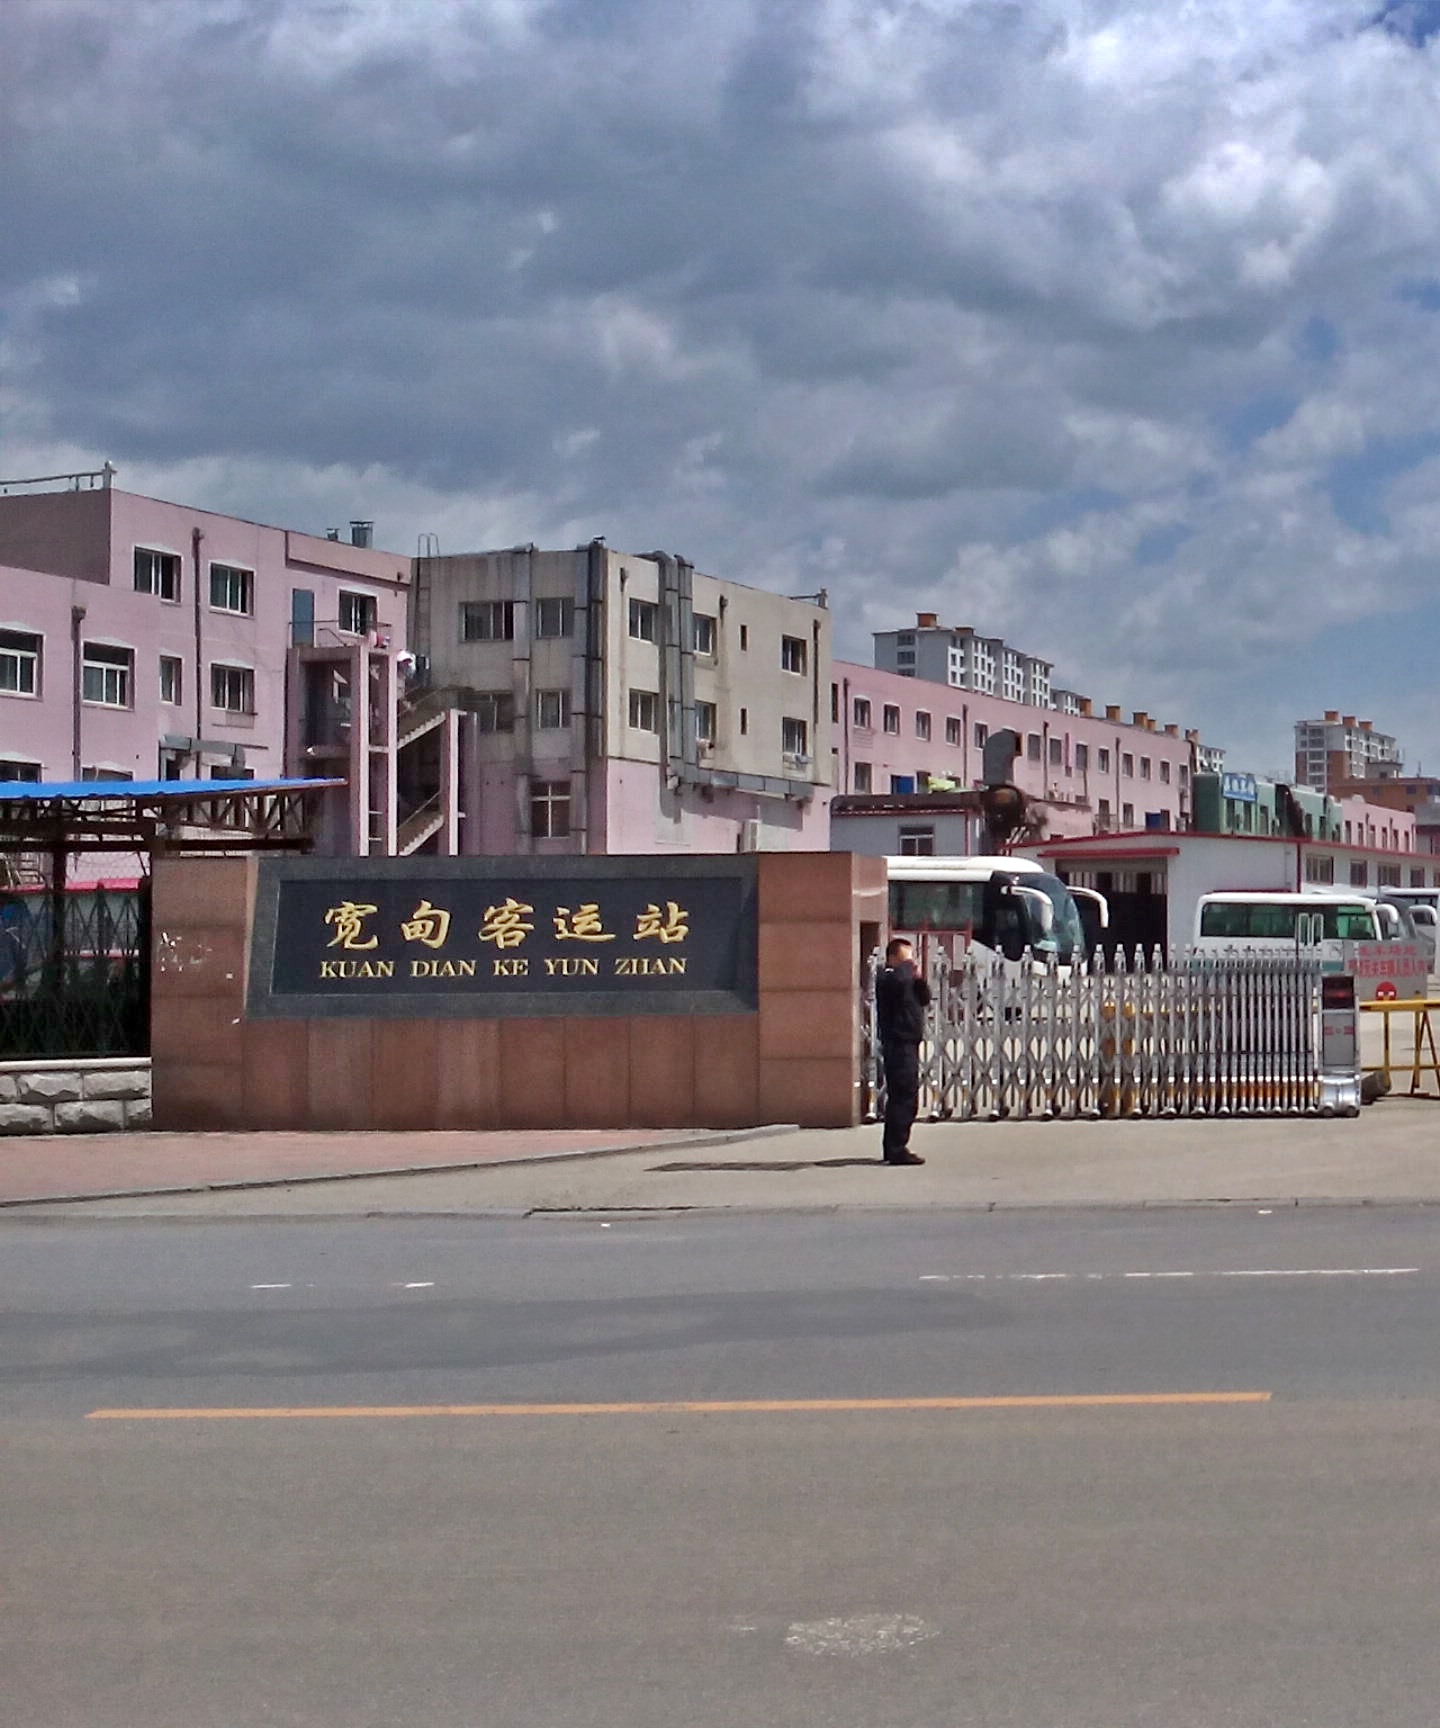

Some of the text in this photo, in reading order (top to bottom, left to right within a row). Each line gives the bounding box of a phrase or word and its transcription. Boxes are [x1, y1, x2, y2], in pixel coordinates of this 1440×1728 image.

[324, 897, 689, 949] 宽甸客运站
[319, 957, 687, 979] KUAN DIAN KE YUN ZHAN
